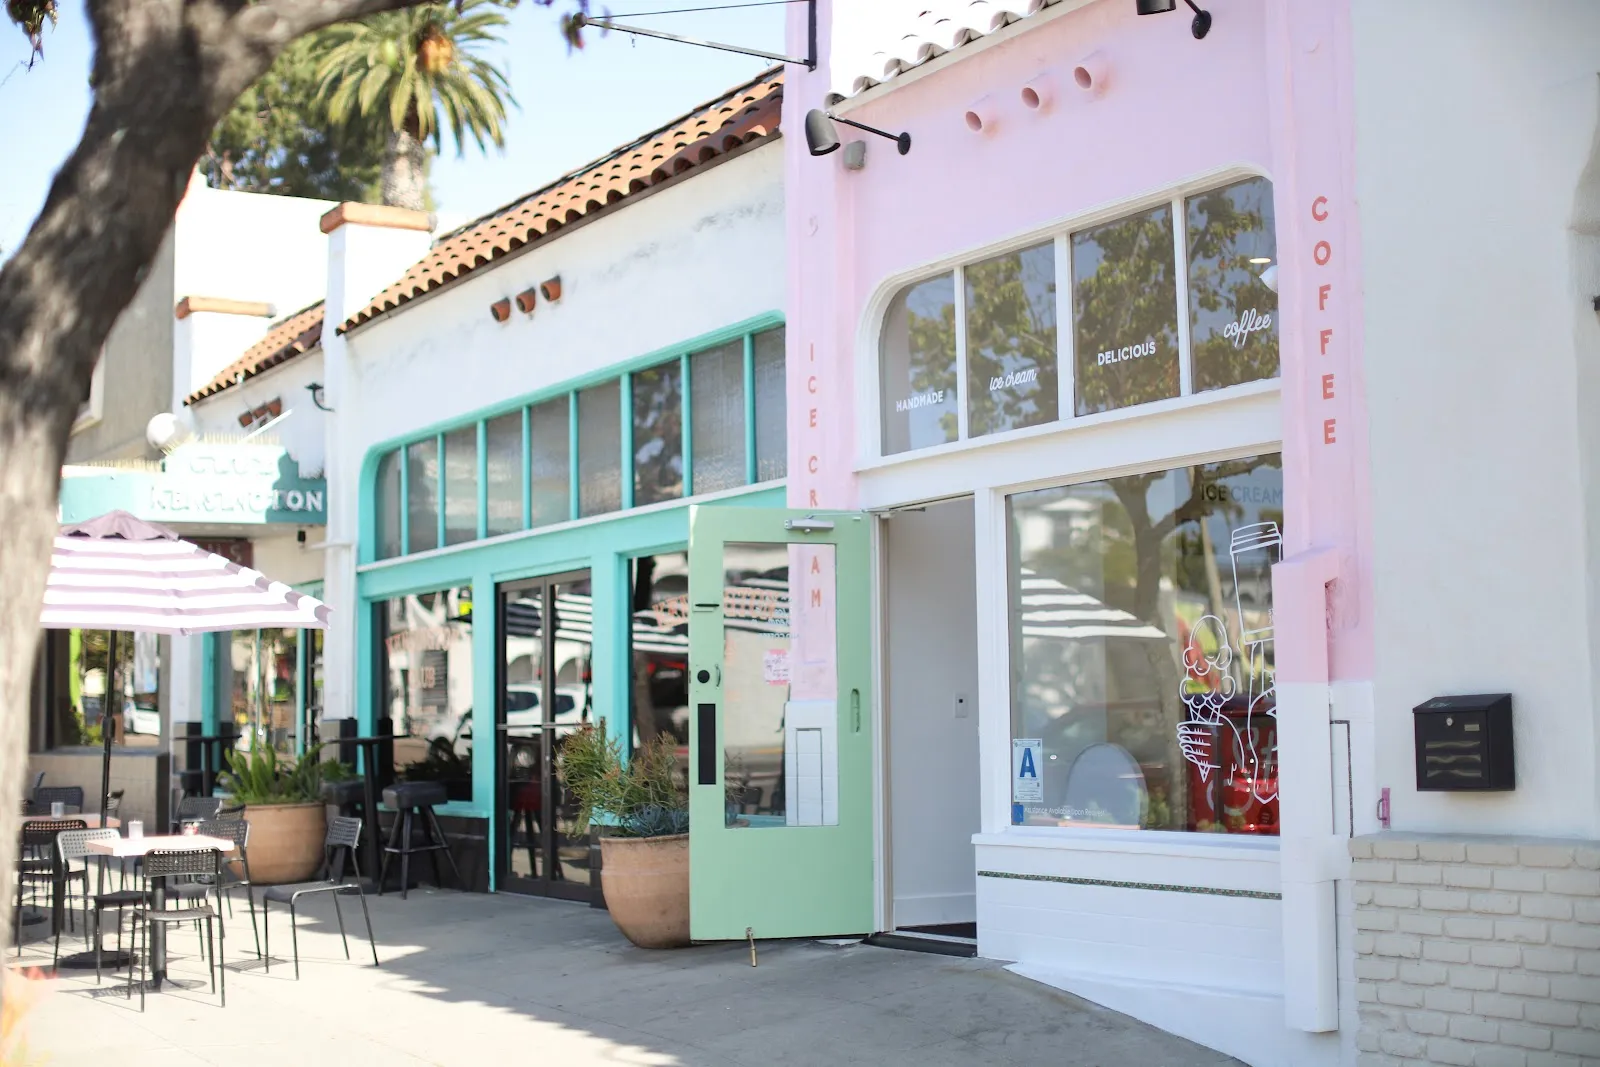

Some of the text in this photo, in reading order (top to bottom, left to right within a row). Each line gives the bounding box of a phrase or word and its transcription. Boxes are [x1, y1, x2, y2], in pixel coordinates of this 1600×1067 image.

[1223, 308, 1272, 348] coffee
[1311, 195, 1336, 445] COFFEE
[1097, 341, 1156, 366] DELICIOUS
[989, 368, 1037, 391] ice cream
[896, 391, 943, 412] HANDMADE
[1201, 485, 1283, 503] ICE CREAM
[808, 455, 822, 608] CRAM
[1020, 747, 1036, 777] A
